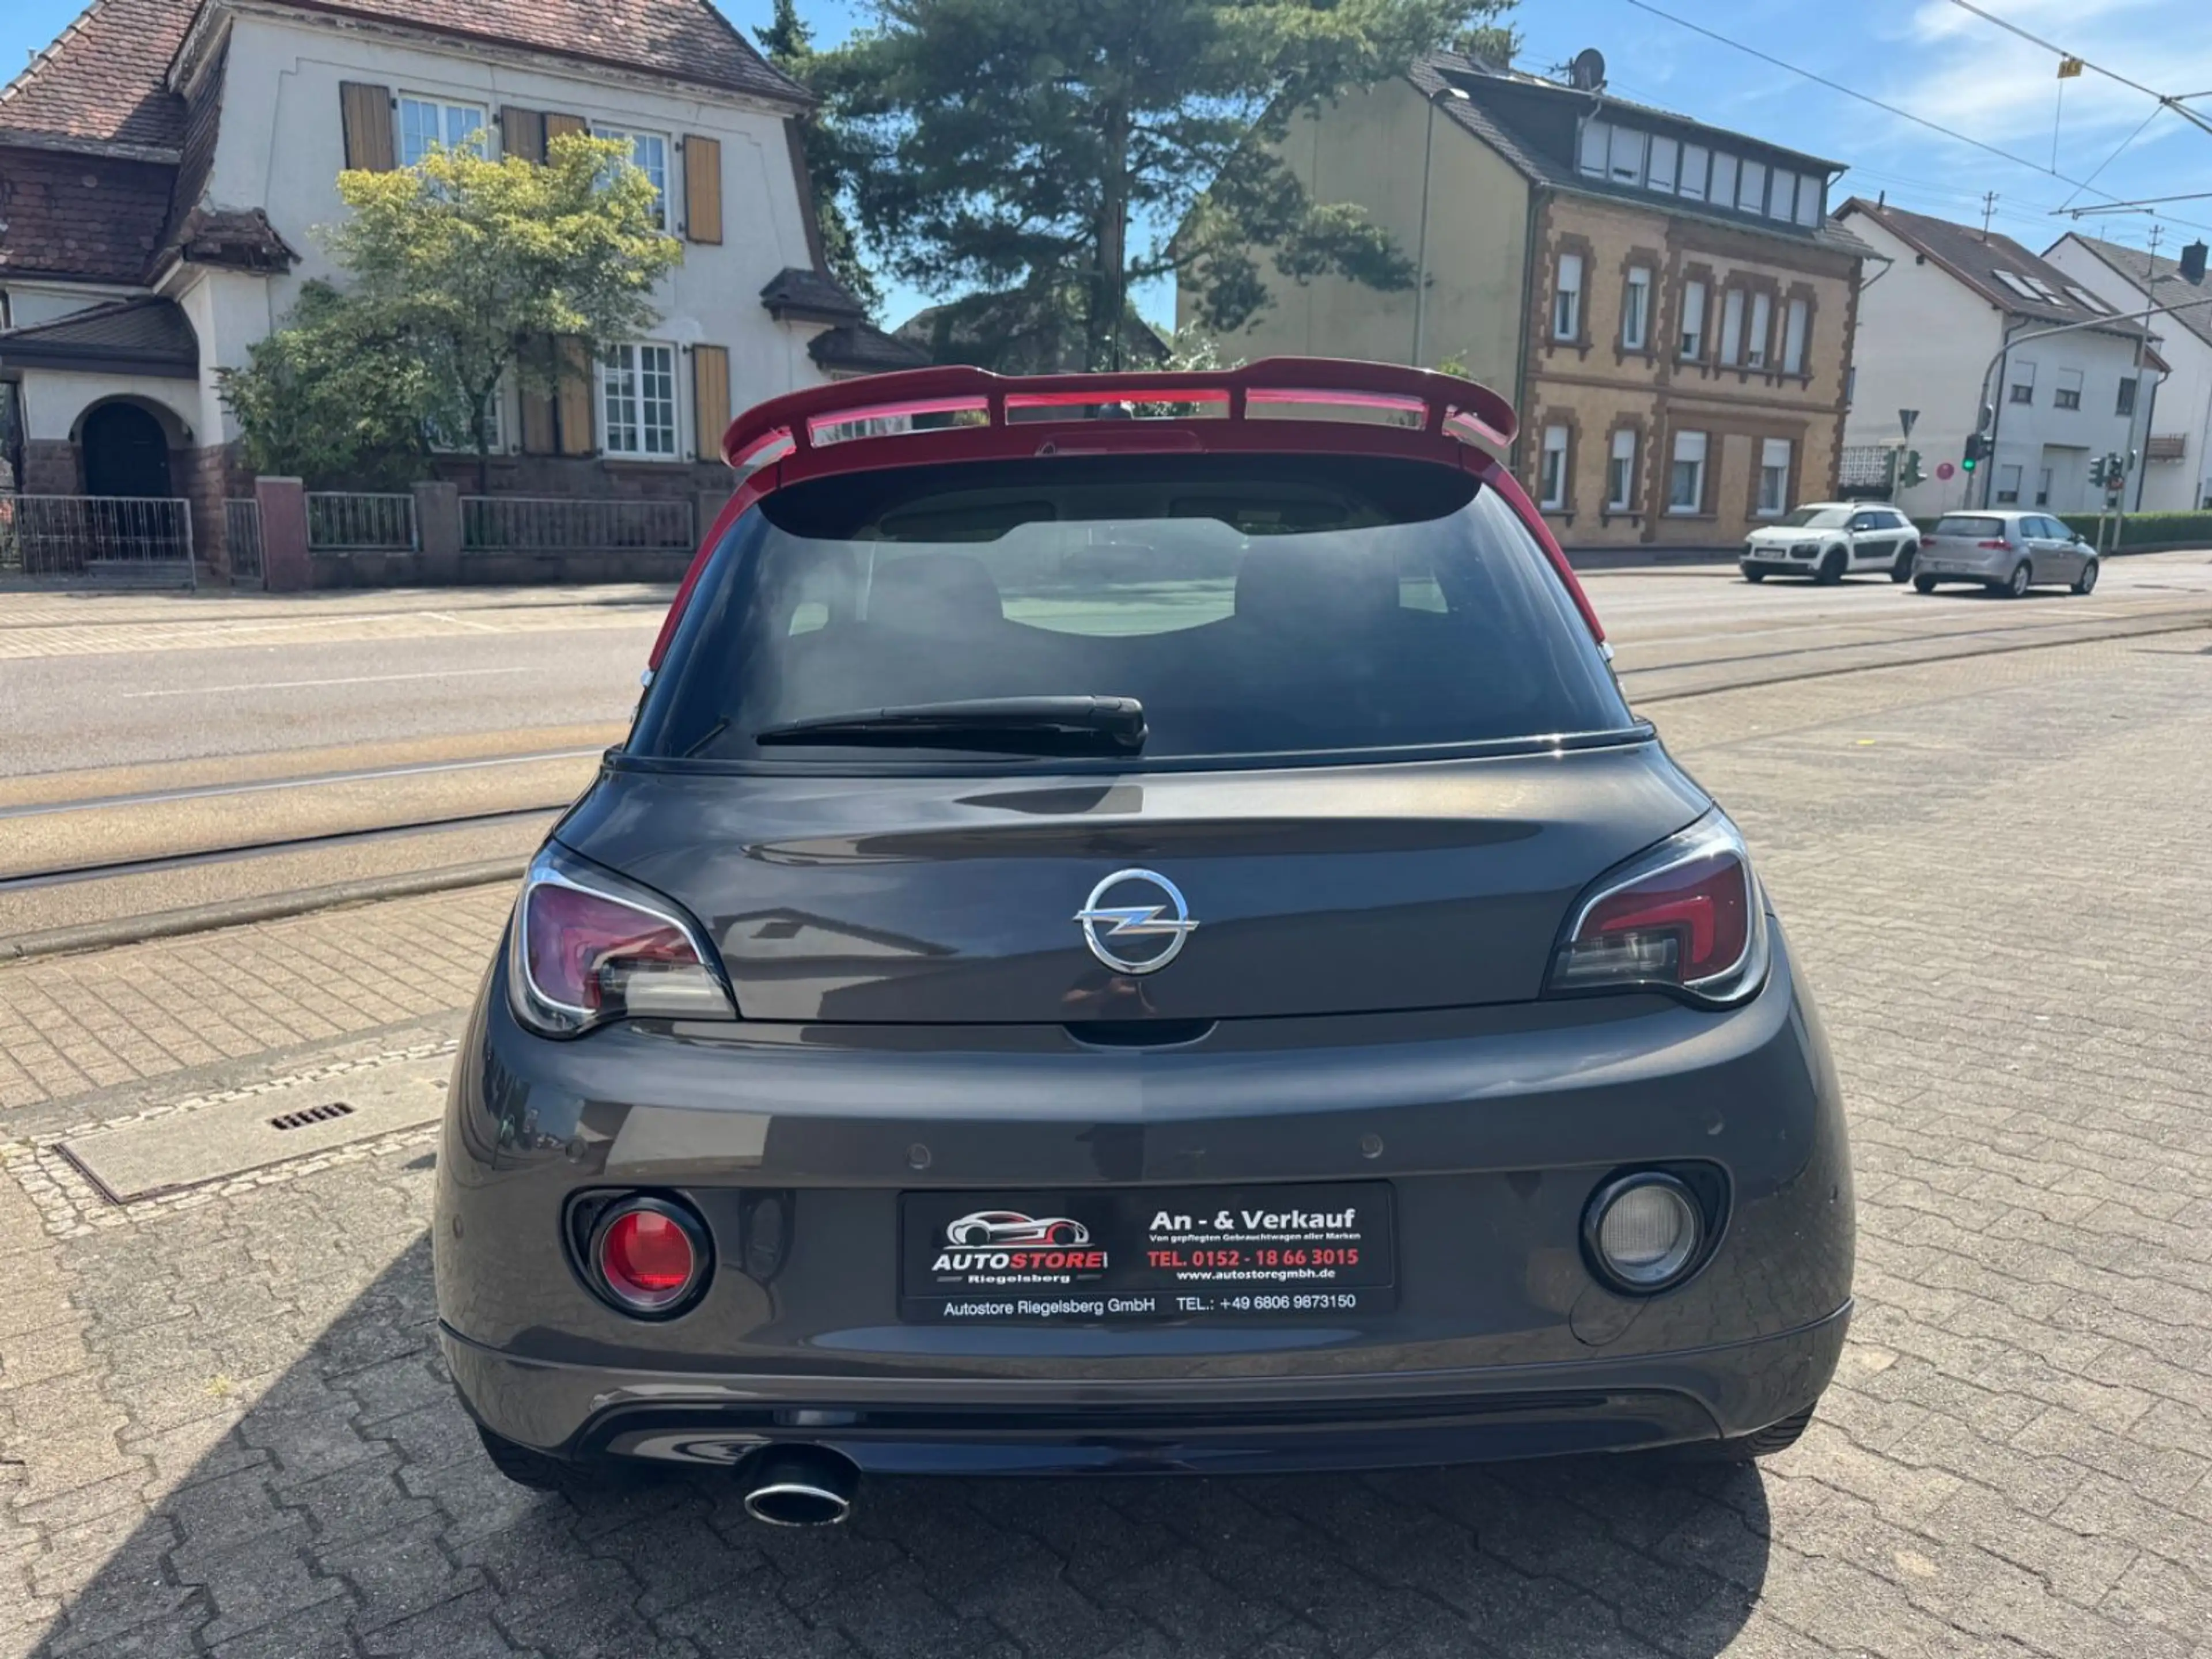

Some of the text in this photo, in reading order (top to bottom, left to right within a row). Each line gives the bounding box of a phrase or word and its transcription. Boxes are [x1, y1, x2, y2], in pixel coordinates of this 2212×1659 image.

[1149, 1211, 1191, 1231] An
[1214, 1210, 1234, 1230] &
[1241, 1208, 1356, 1229] Verkauf
[931, 1252, 1103, 1271] AUTOSTORE
[1147, 1251, 1187, 1267] TEL.
[1192, 1250, 1240, 1267] 0152
[1256, 1250, 1278, 1266] 18
[1283, 1249, 1307, 1266] 66
[1311, 1248, 1359, 1265] 3015
[967, 1274, 1071, 1285] Riegelsberg
[1176, 1268, 1336, 1282] www.autostoregmbh.de
[943, 1298, 1155, 1317] Autostore Riegelsberg GmbH
[1176, 1294, 1357, 1311] TEL.: +49 6806 9873150
